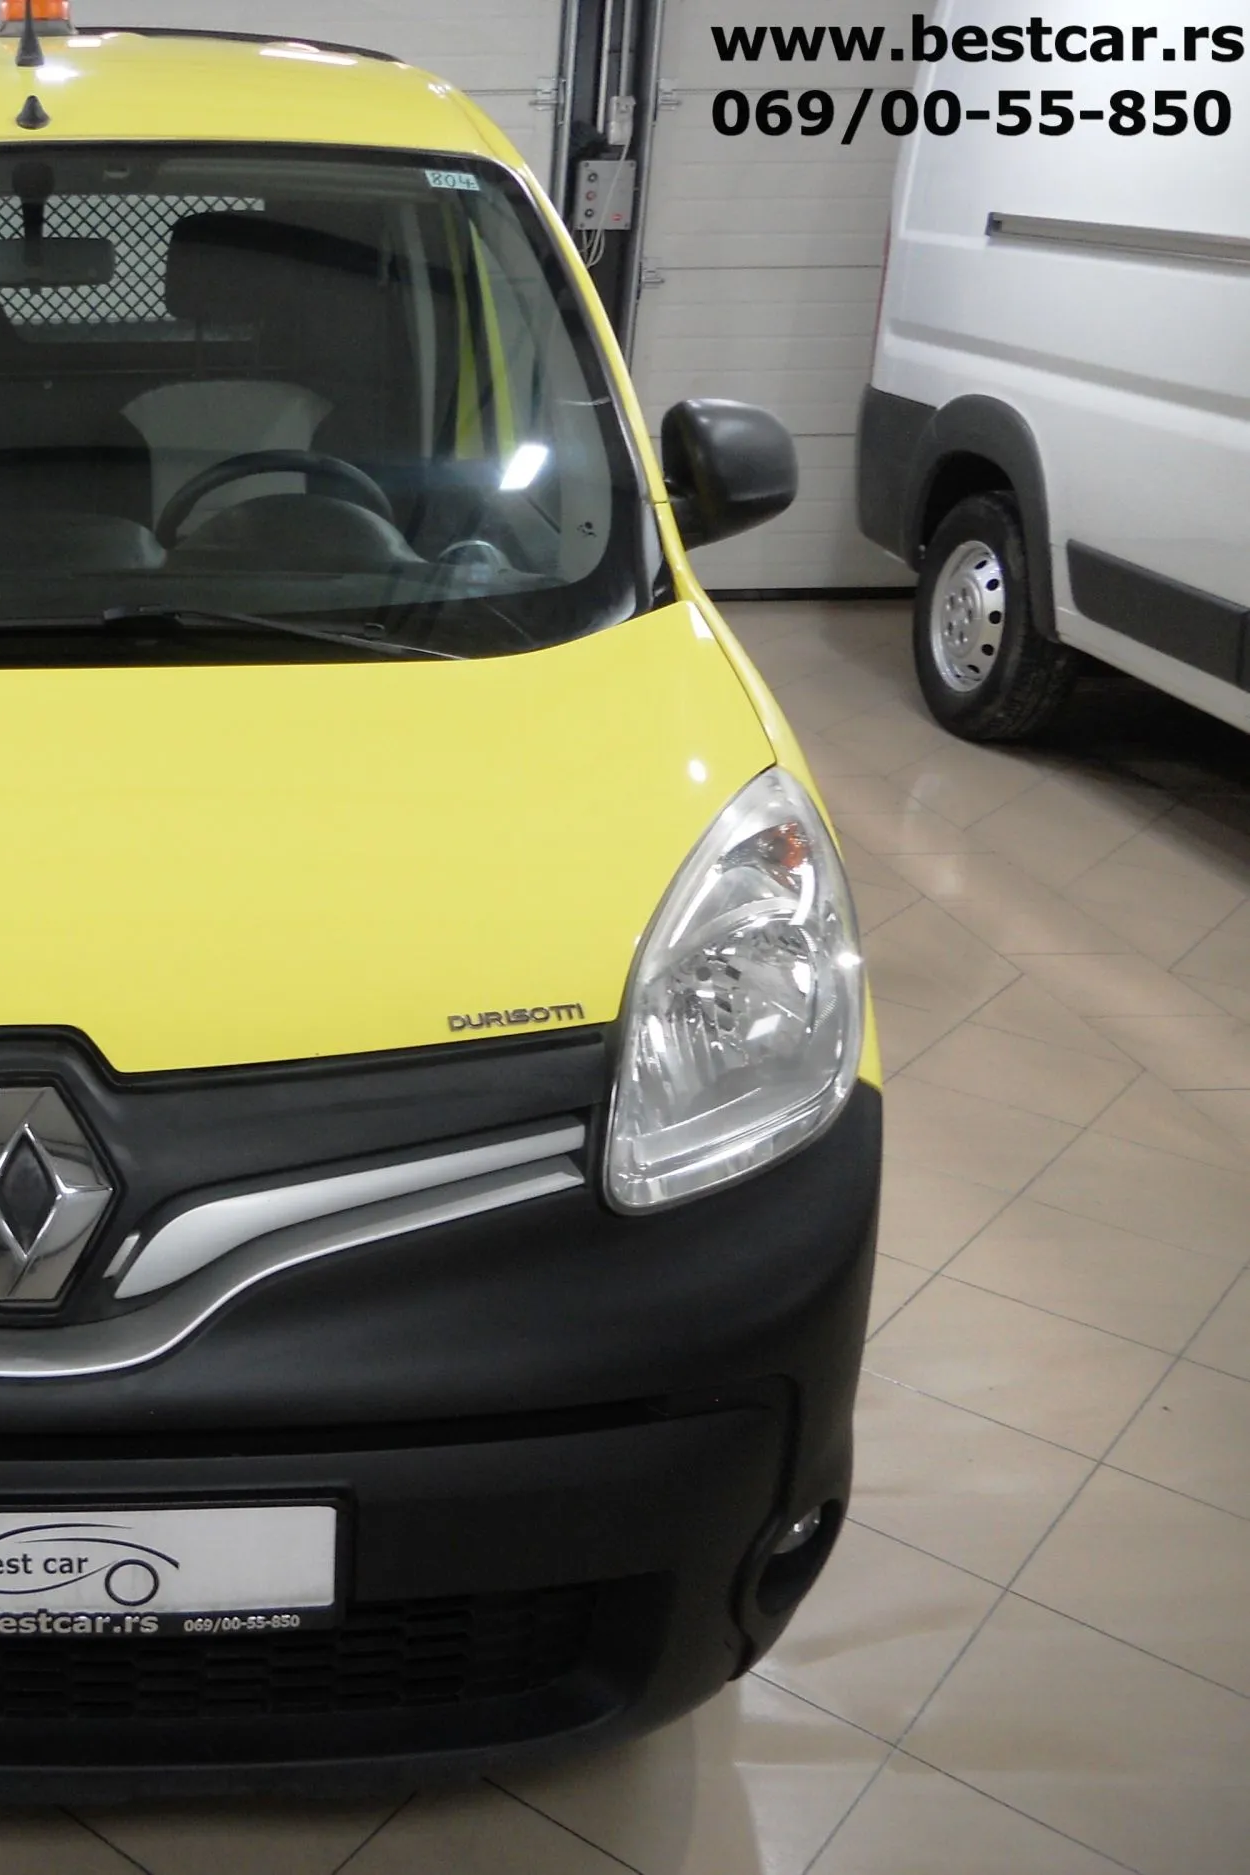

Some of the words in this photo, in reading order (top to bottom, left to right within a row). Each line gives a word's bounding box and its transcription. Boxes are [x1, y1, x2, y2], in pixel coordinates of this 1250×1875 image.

[447, 1002, 585, 1032] DURISOTTI
[43, 1557, 89, 1575] car
[183, 1614, 301, 1632] 069/00-55-850
